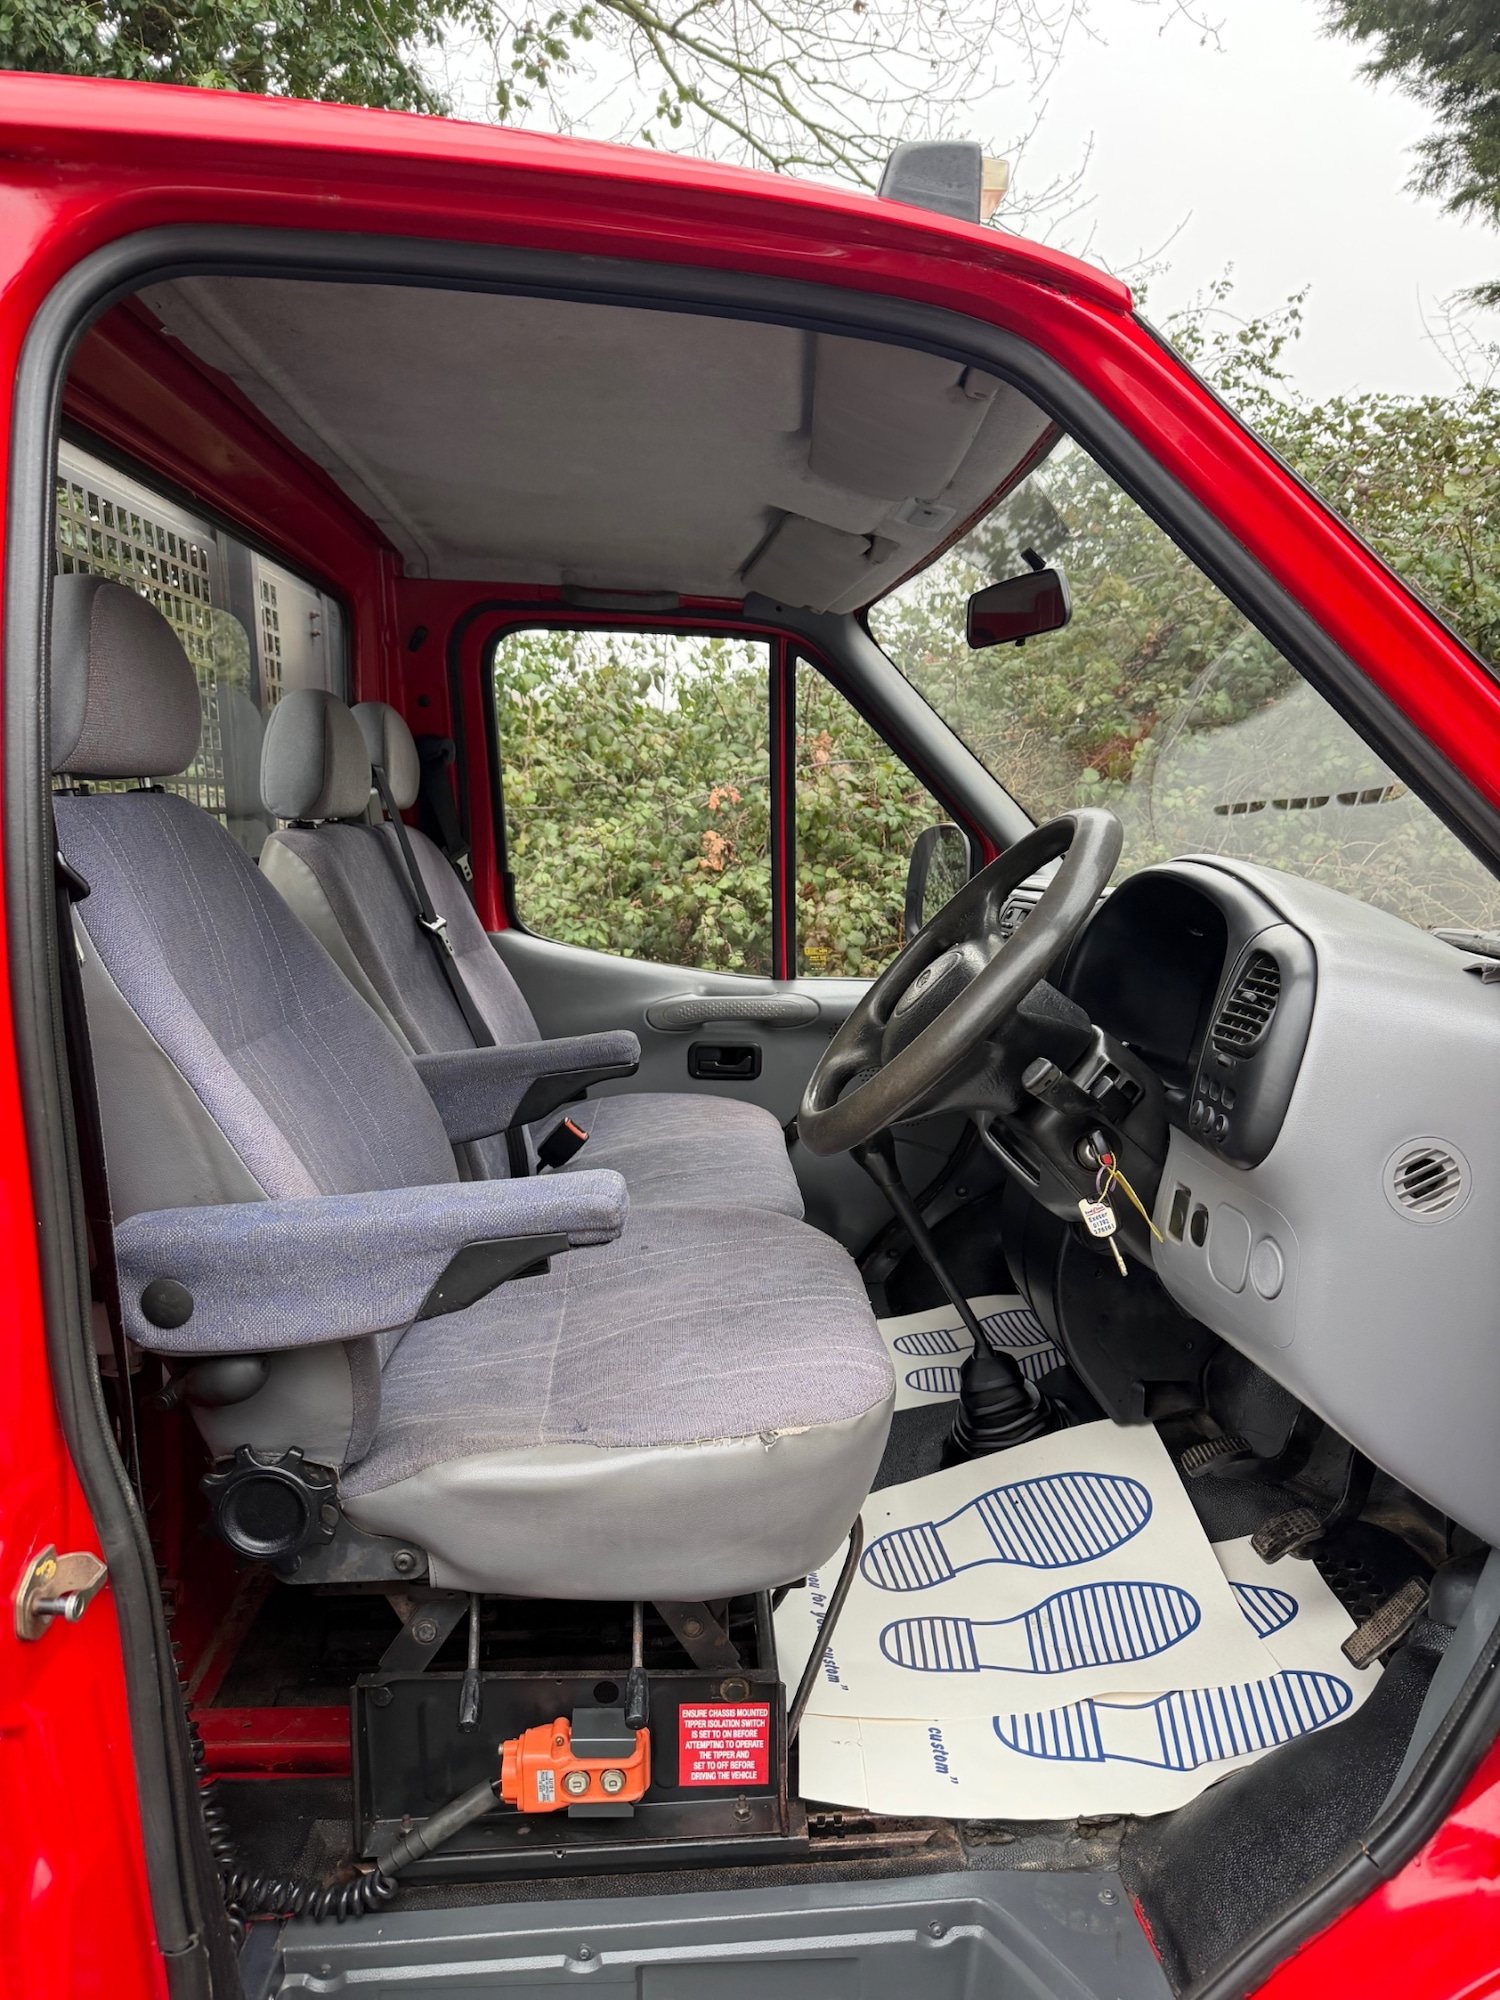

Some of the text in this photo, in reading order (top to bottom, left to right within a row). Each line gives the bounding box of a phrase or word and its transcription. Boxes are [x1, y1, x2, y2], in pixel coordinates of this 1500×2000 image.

[1088, 1212, 1107, 1223] Exeter
[811, 1592, 827, 1608] for
[682, 1708, 768, 1718] ENSURE CHASSIS MOUNTED
[684, 1719, 765, 1728] TIPPER ISOLATION SWITCH
[691, 1729, 758, 1738] IS SET TO ON BEFORE
[685, 1740, 764, 1749] ATTEMPTING TO OPERATE
[699, 1750, 749, 1759] THE TIPPER AND
[693, 1760, 755, 1770] SET TO OFF BEFORE
[691, 1771, 757, 1780] DRIVING THE VEHICLE
